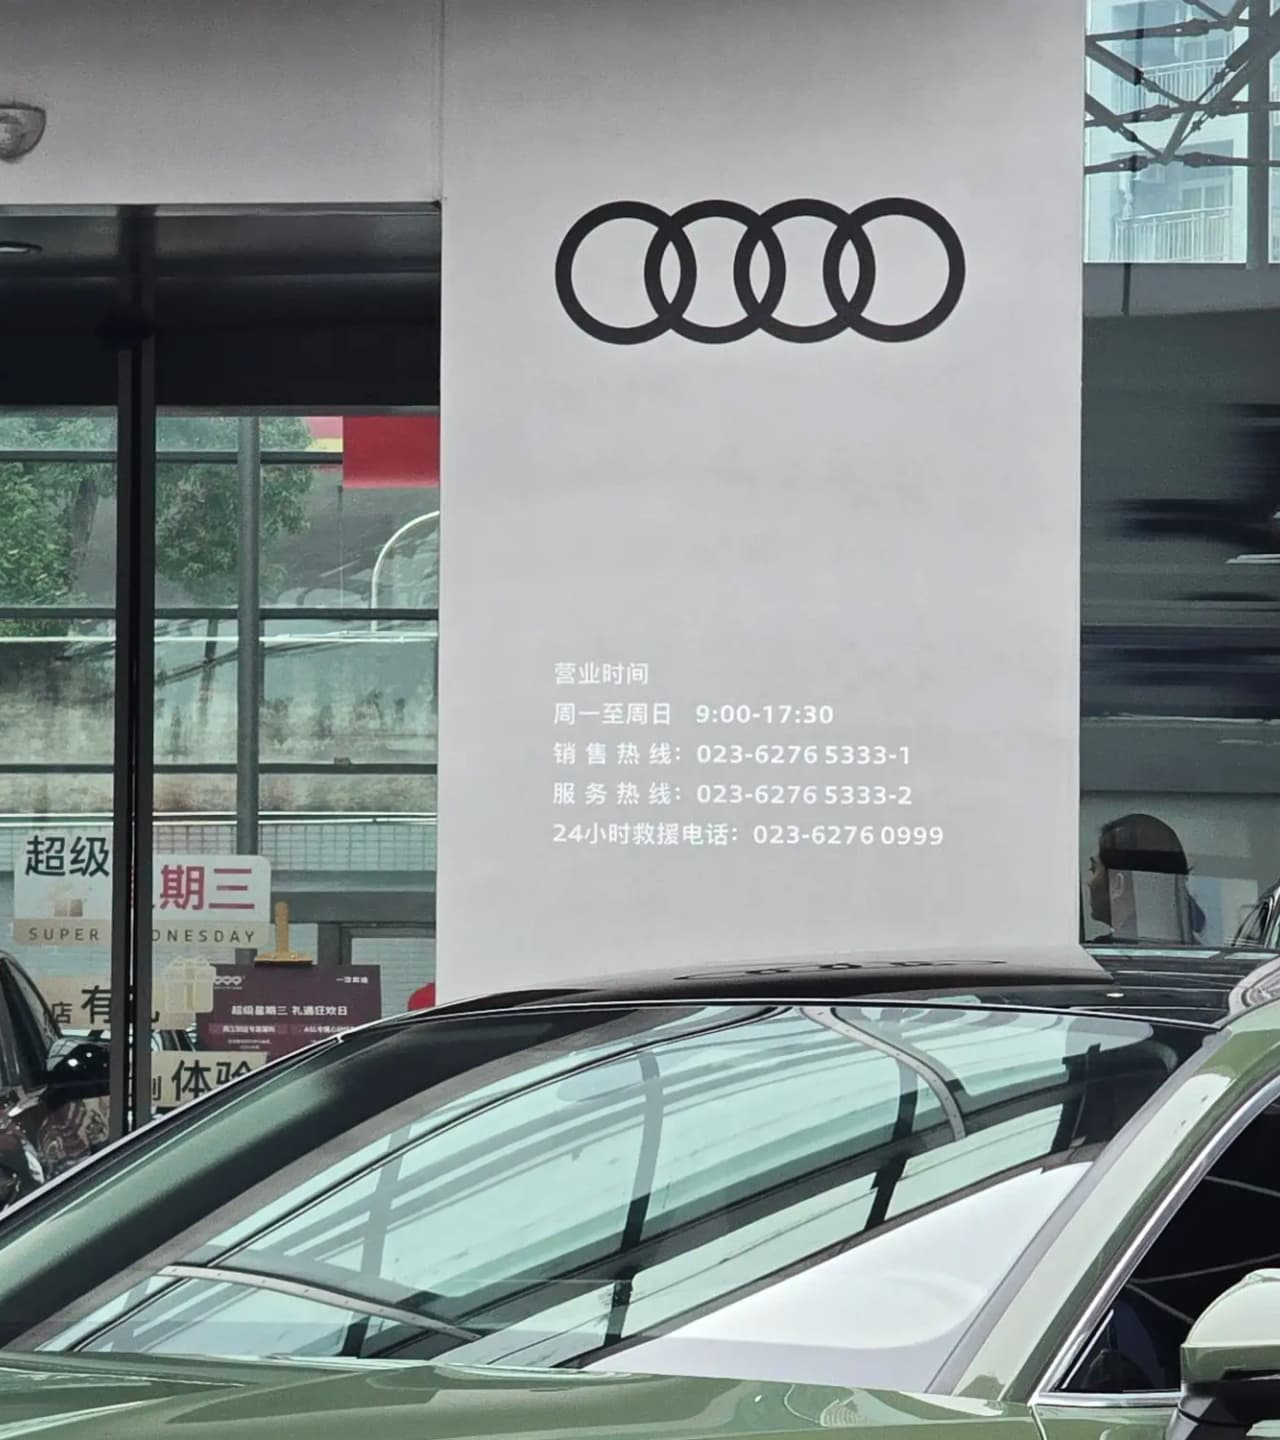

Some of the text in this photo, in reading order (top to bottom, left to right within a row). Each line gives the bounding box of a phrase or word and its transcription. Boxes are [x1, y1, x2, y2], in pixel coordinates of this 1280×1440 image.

[554, 661, 649, 685] 营业时间
[553, 703, 834, 725] 周一至周日 9:00-17:30
[696, 744, 818, 764] 023-6276
[825, 745, 910, 765] 5333-1
[696, 784, 818, 804] 023-6276
[825, 785, 913, 805] 5333-2
[753, 824, 874, 845] 023-6276
[880, 826, 944, 846] 0999
[25, 835, 110, 878] 超级
[152, 864, 256, 911] 期三
[29, 927, 255, 944] SUPER DNESDAY
